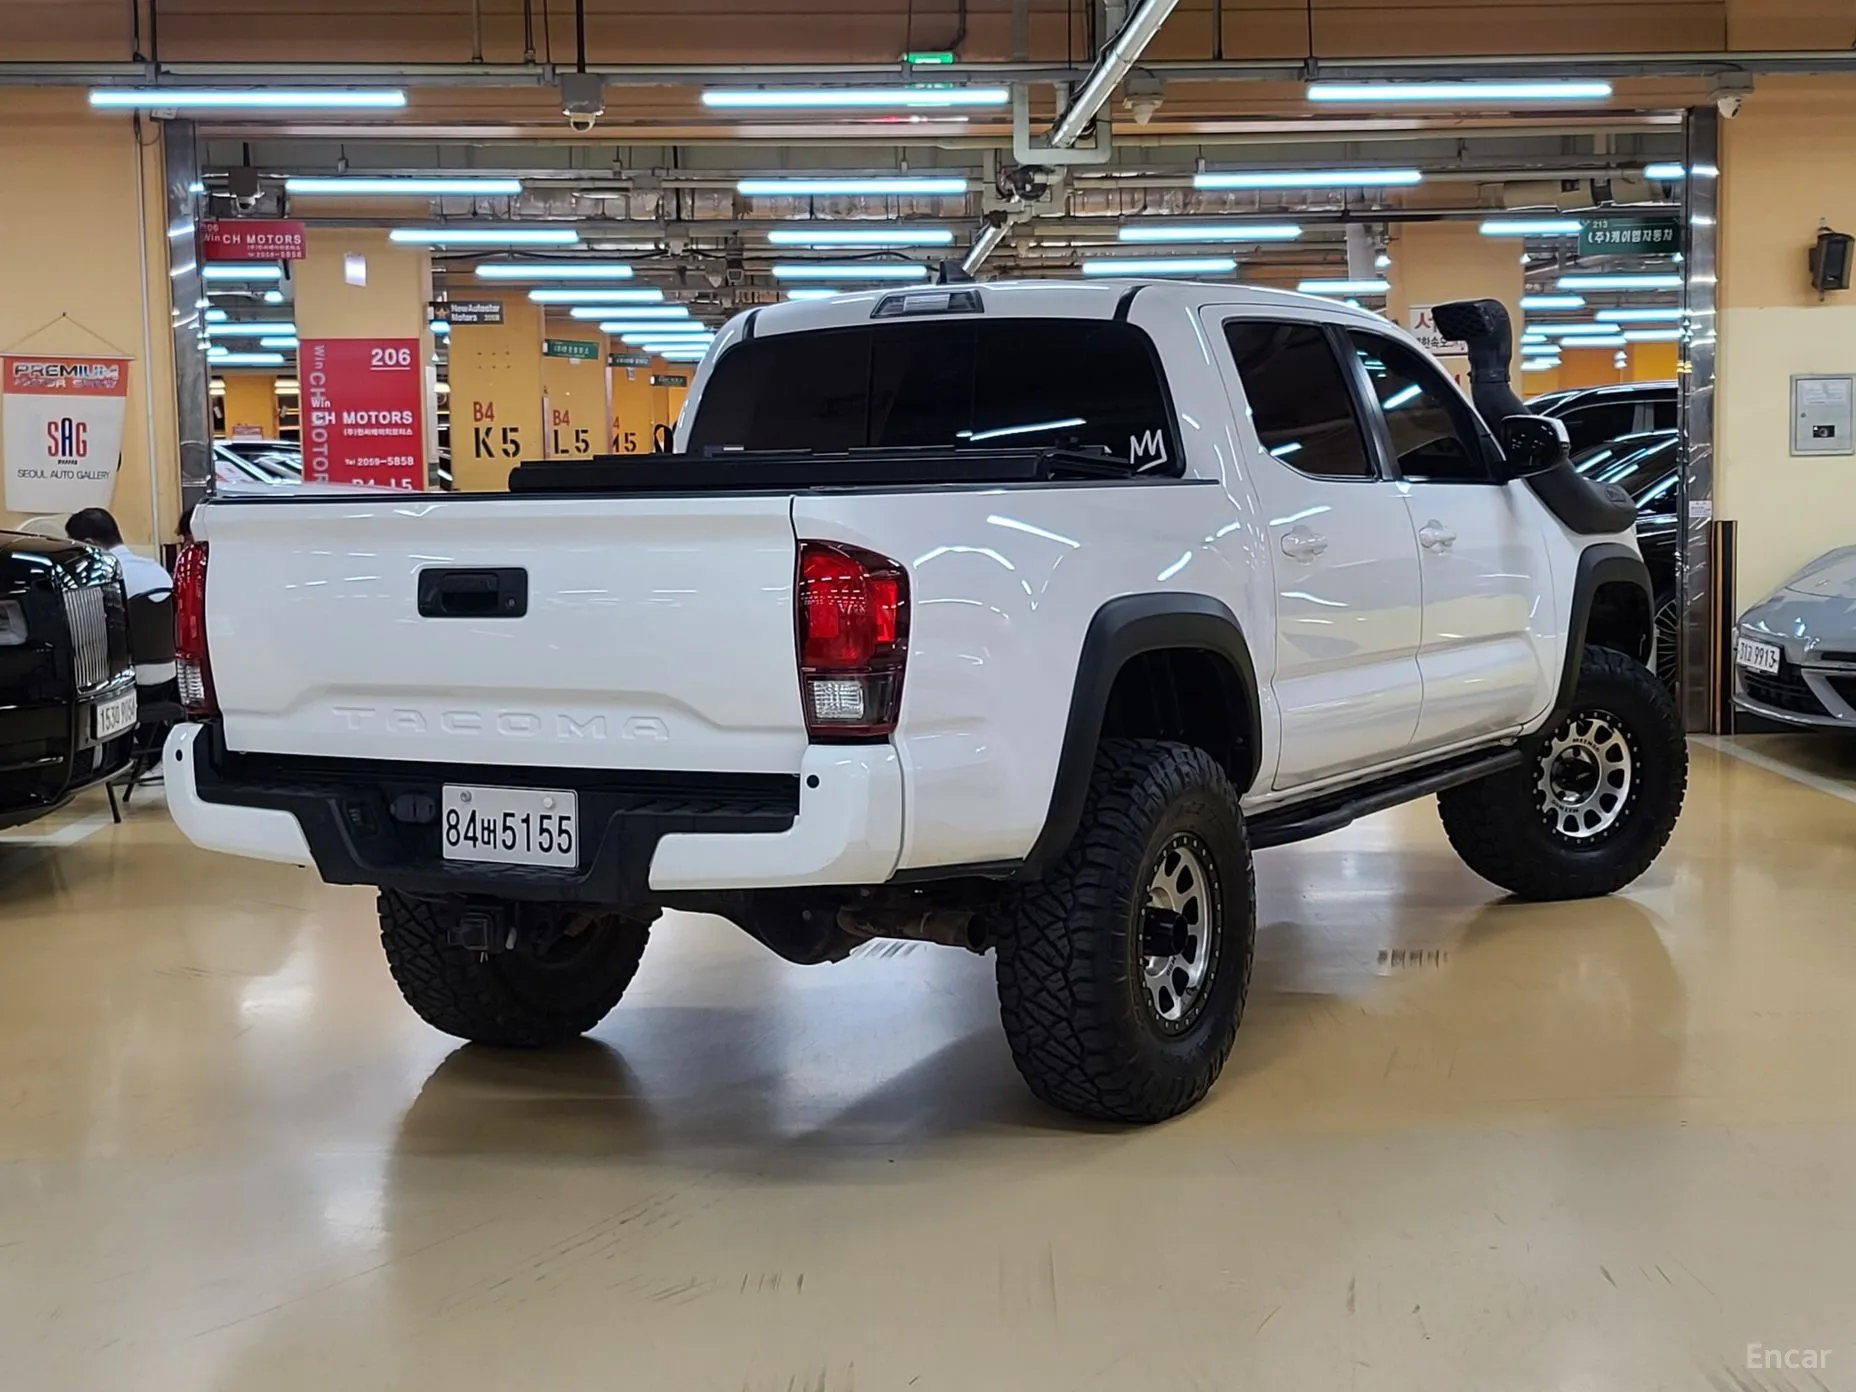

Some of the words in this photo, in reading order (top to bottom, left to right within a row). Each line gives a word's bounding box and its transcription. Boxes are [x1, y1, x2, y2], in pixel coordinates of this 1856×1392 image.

[222, 234, 241, 244] CH
[246, 234, 302, 245] MOTORS
[371, 348, 411, 367] 206
[13, 362, 119, 379] PREMIUM
[342, 410, 413, 425] MOTORS
[473, 401, 495, 422] B4
[552, 409, 570, 426] B4
[47, 417, 88, 458] SAG
[17, 469, 48, 480] SEOUL
[50, 470, 75, 480] AUTO
[76, 471, 111, 481] GALLERY
[332, 706, 671, 741] TACOMA
